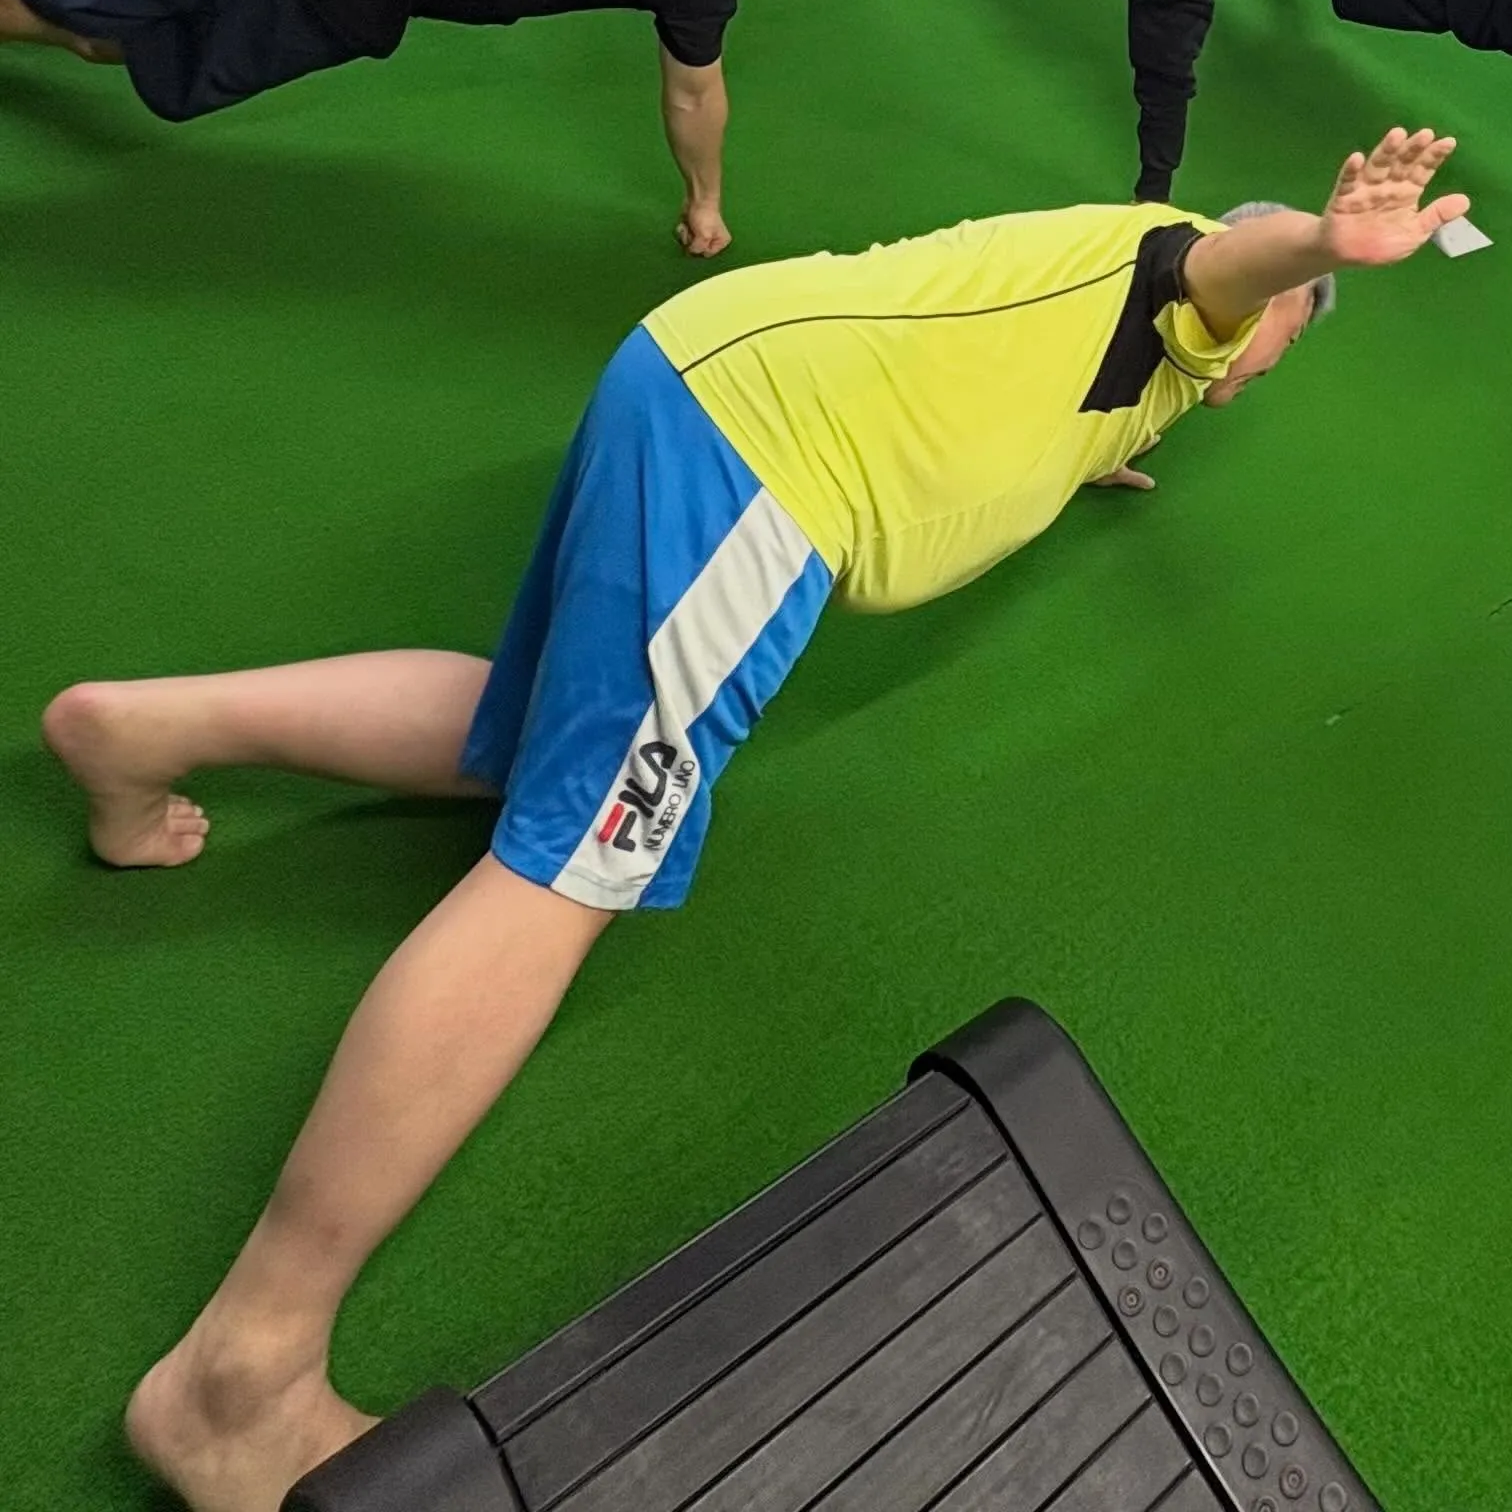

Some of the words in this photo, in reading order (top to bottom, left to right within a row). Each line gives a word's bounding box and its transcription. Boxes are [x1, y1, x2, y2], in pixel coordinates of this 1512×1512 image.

[597, 741, 678, 853] FILA
[644, 793, 682, 851] NUMERO
[672, 760, 696, 789] UNO
